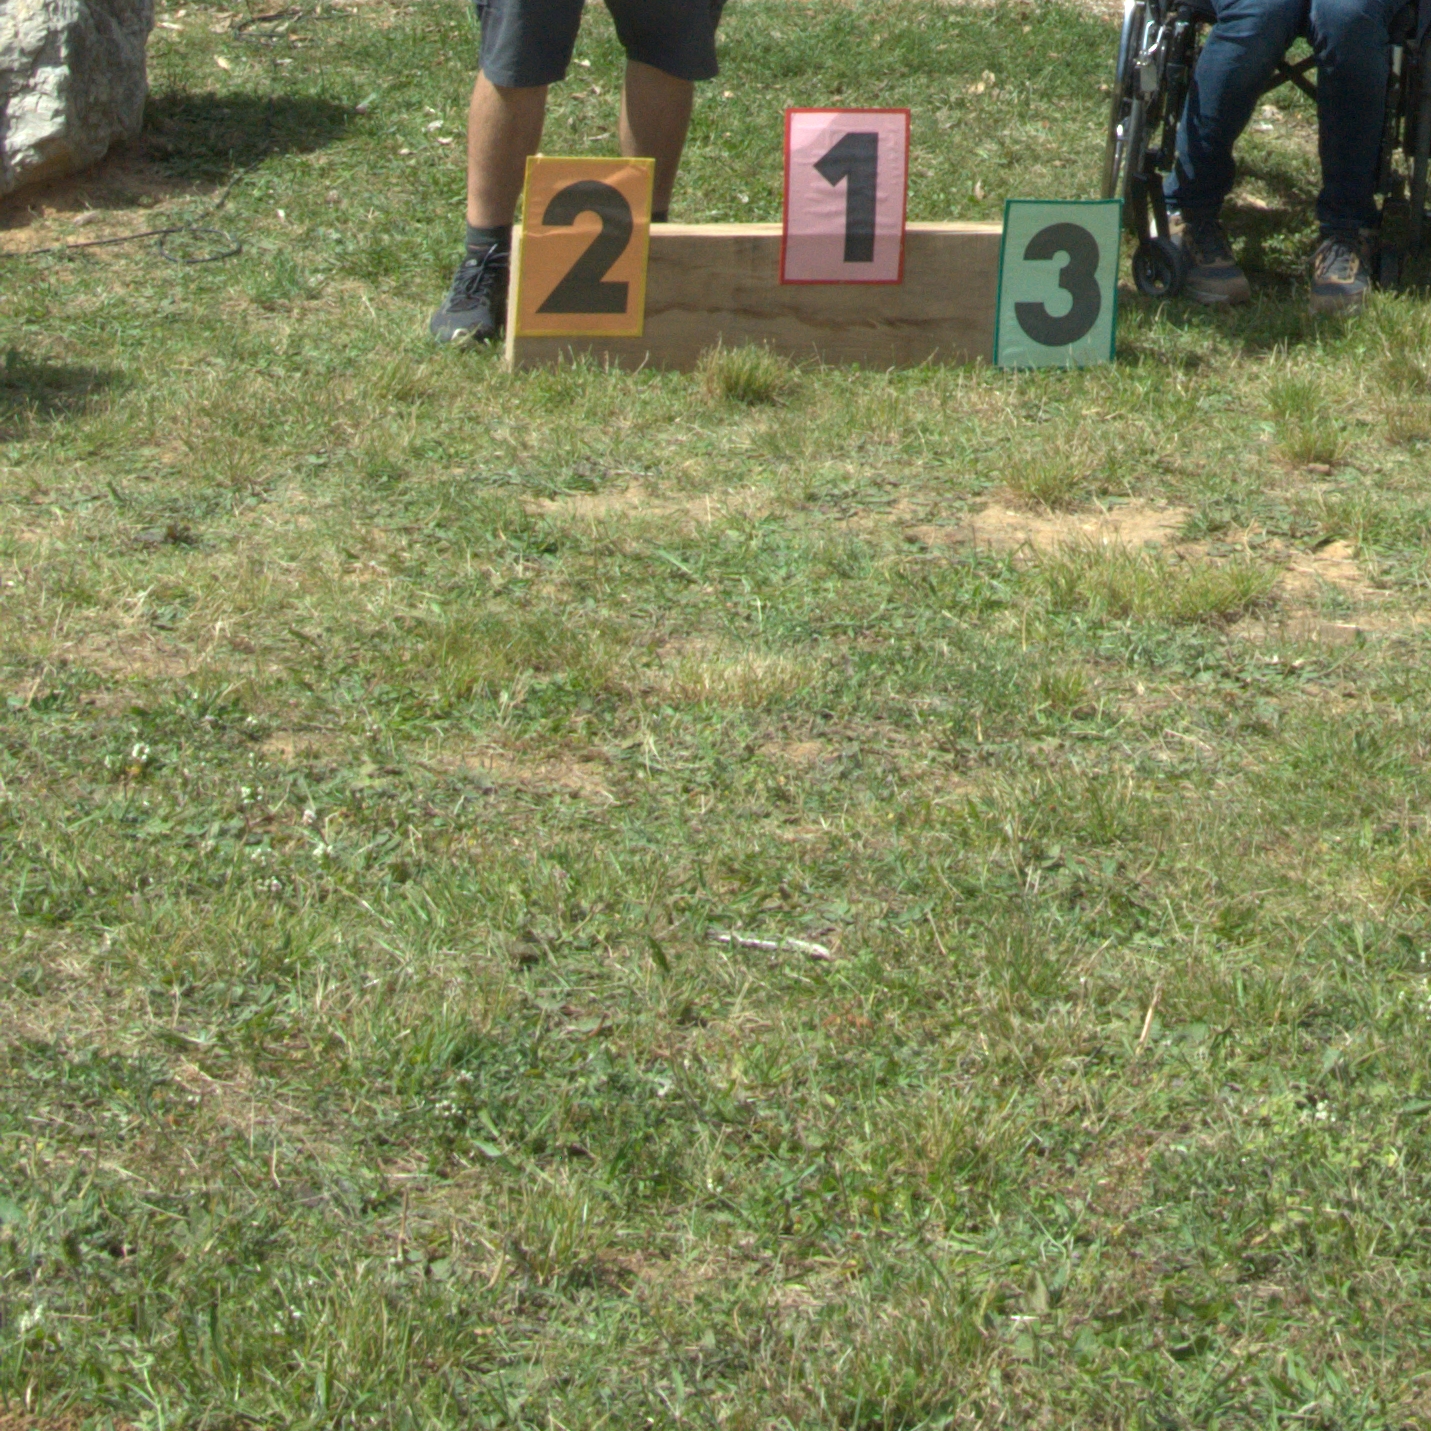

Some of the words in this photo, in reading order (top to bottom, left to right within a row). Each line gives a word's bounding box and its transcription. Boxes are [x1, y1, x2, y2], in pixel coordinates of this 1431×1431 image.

[535, 180, 634, 314] 2
[813, 132, 879, 263] 1
[1014, 222, 1102, 347] 3
